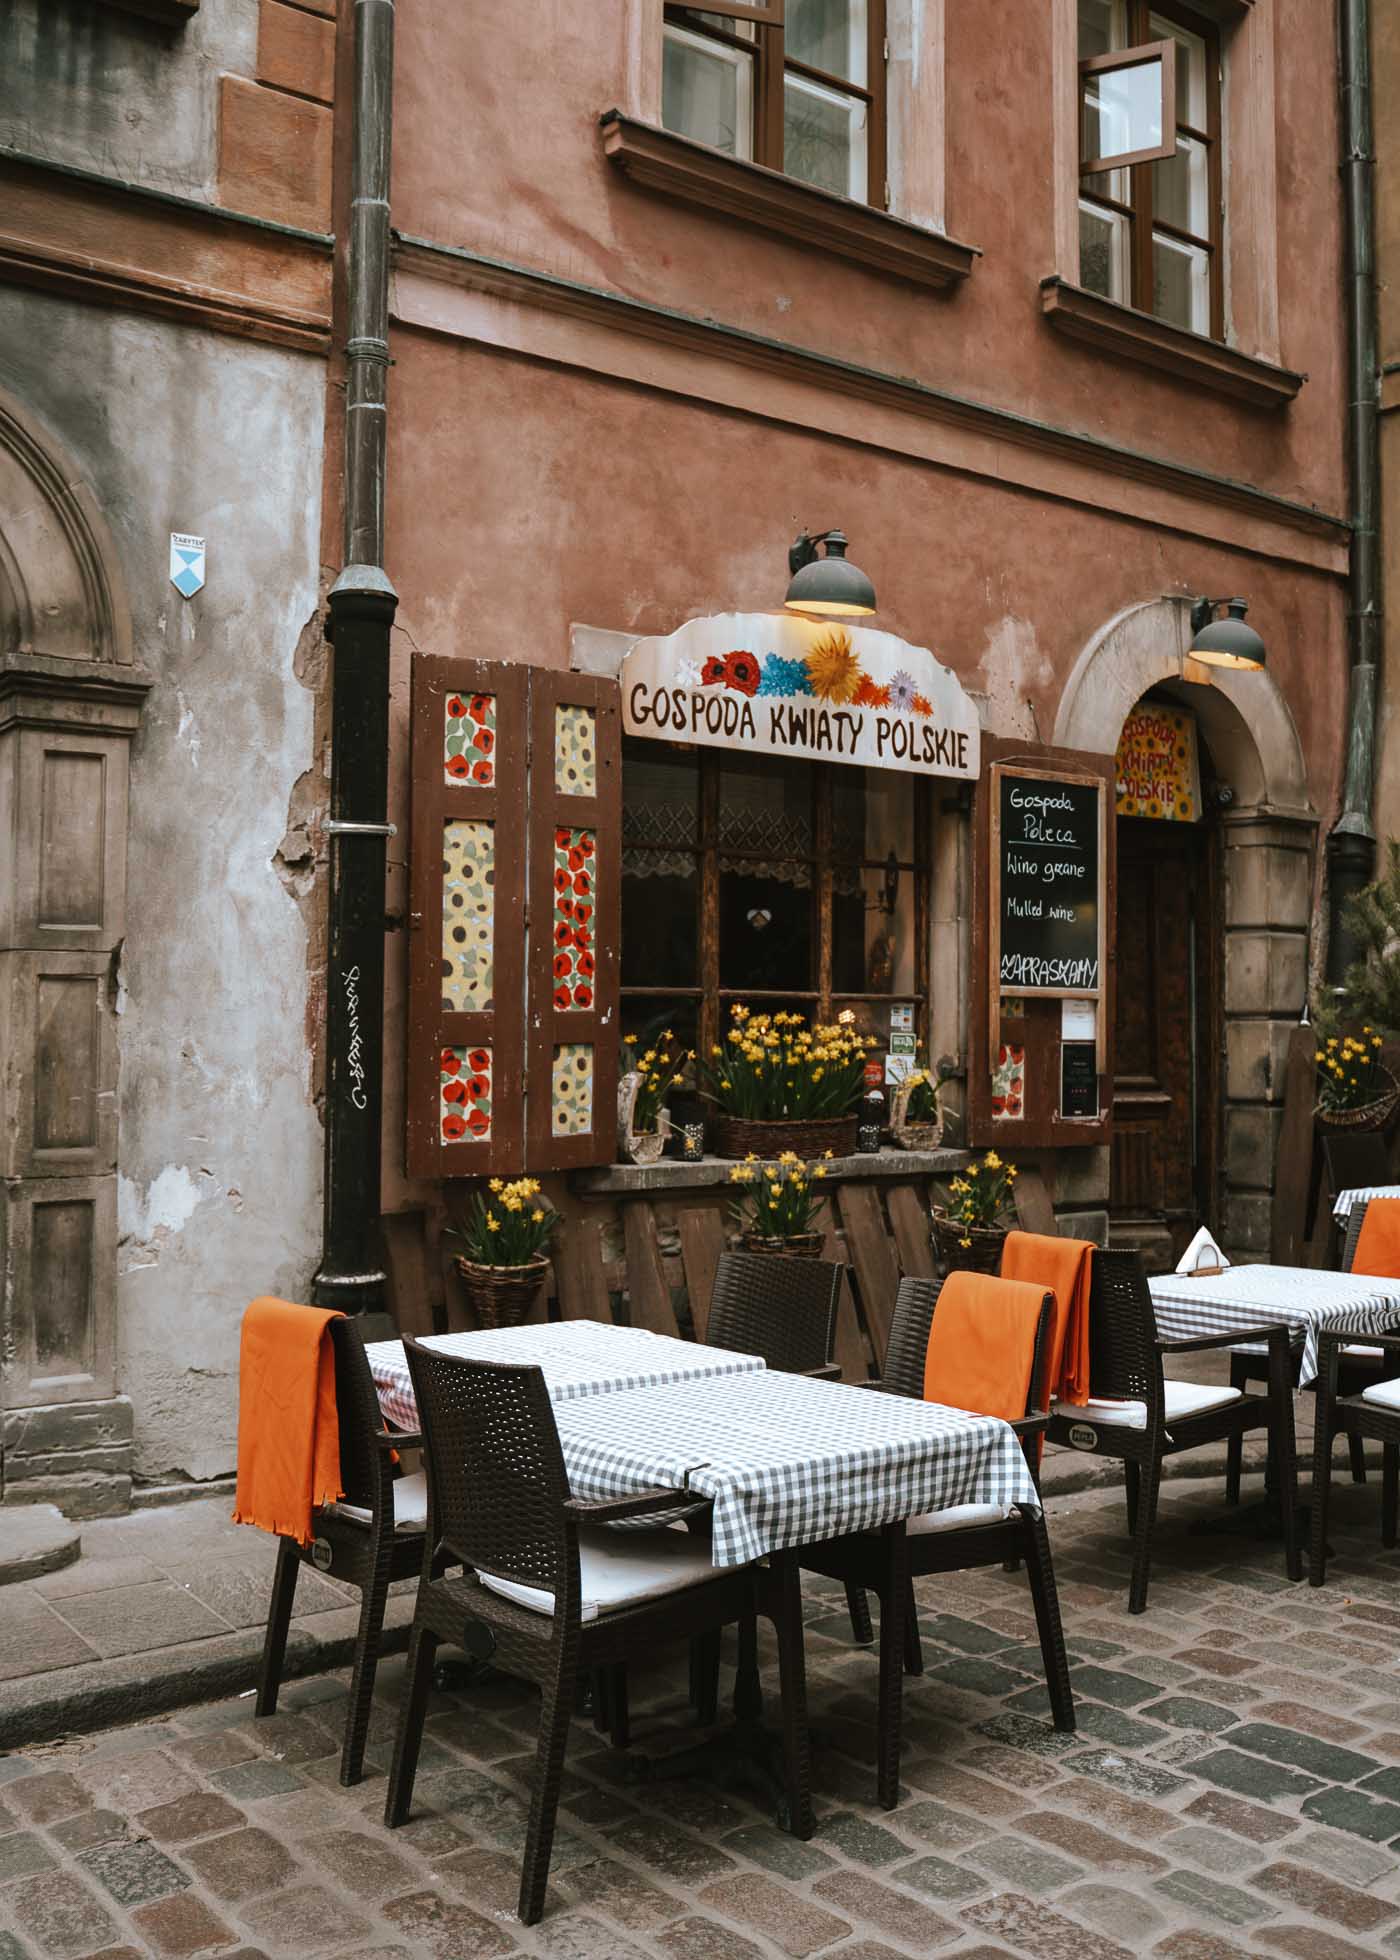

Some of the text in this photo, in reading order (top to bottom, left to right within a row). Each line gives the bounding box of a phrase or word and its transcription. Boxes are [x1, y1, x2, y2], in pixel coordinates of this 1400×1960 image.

[630, 682, 969, 769] GOSPODA KWIATY POLSKIE
[1010, 788, 1076, 817] Gospoda
[1023, 814, 1077, 842] Poleca
[1007, 852, 1038, 876] Wino
[1007, 897, 1043, 917] Mulled
[1000, 953, 1098, 989] ZAPRASZAMY
